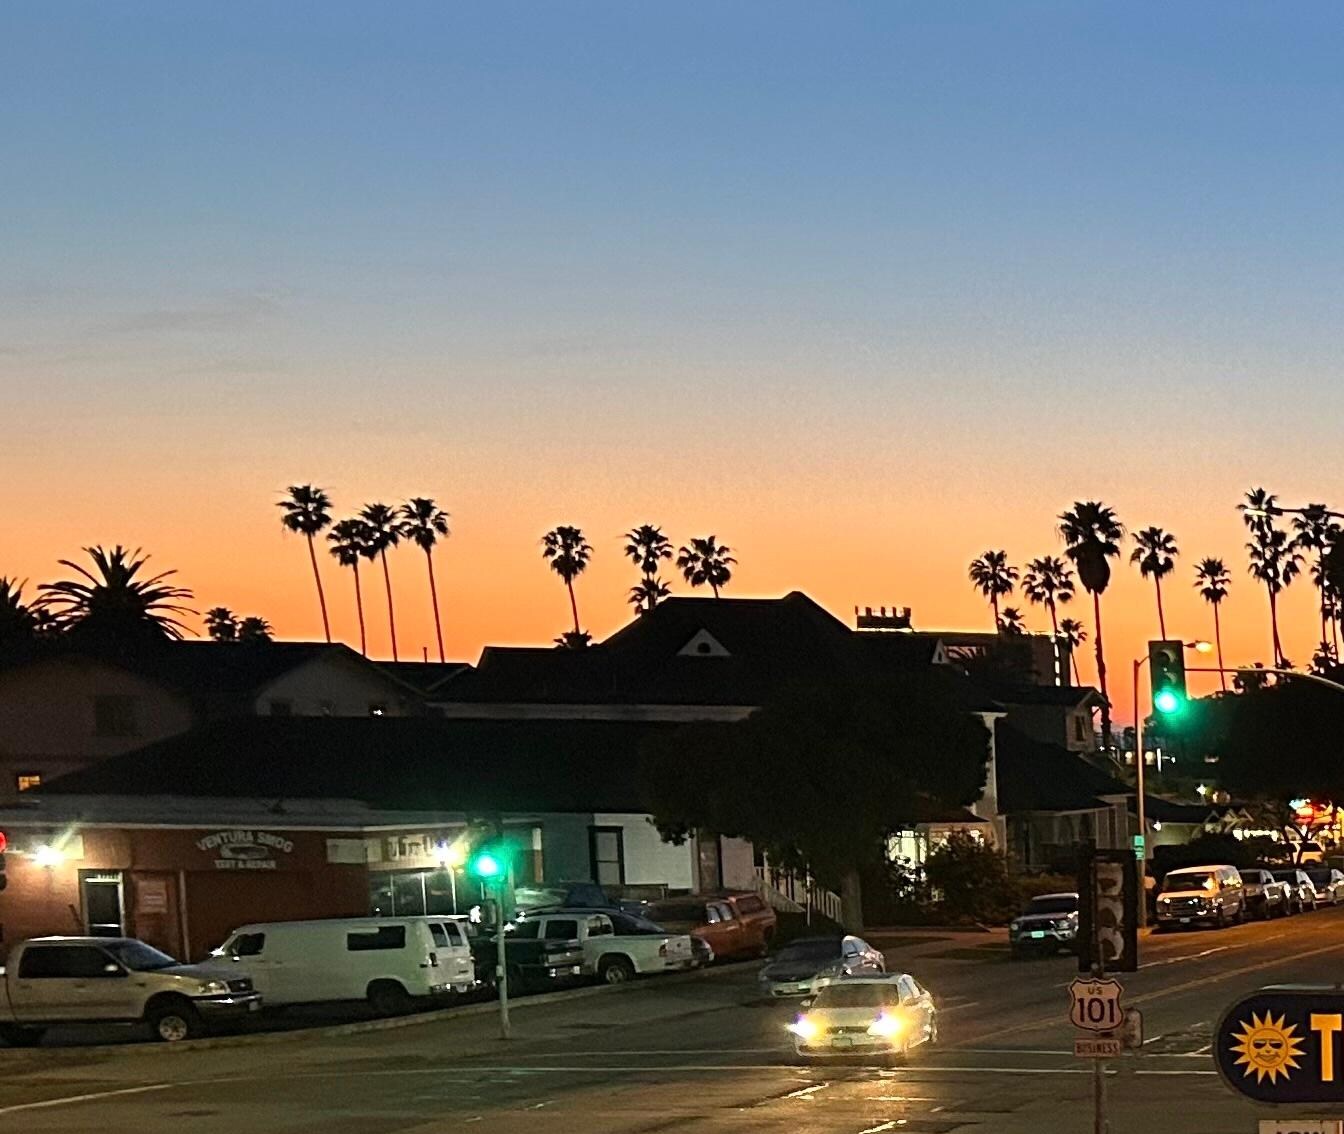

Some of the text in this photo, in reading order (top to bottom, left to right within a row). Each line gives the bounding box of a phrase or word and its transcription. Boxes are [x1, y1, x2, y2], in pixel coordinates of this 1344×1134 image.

[195, 830, 293, 852] VENTURA SMOG
[1087, 986, 1103, 995] US
[1077, 997, 1115, 1023] 101
